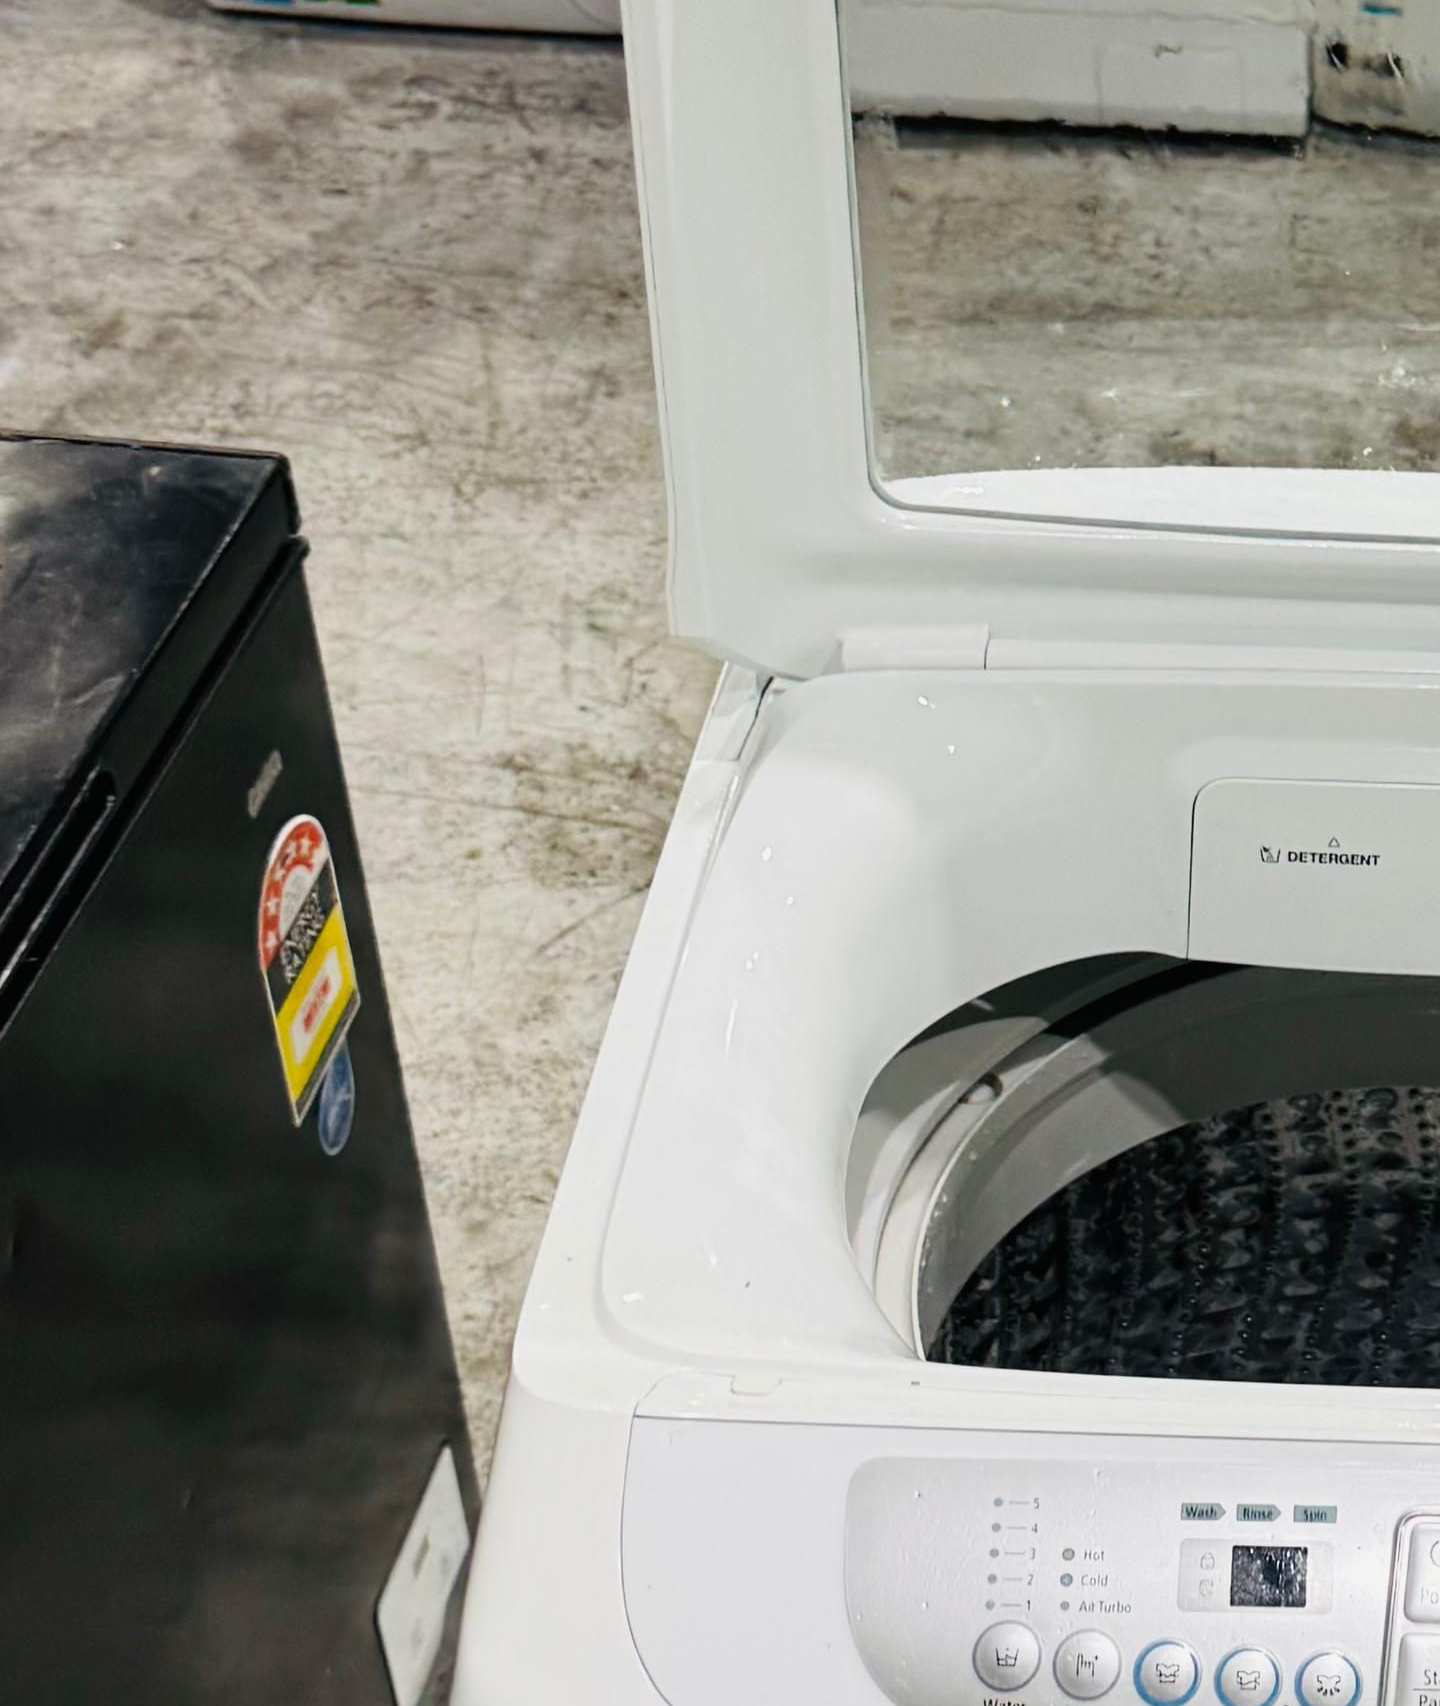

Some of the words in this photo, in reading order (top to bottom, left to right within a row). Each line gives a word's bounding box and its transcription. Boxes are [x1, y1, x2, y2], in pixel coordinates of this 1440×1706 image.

[1287, 850, 1381, 867] DETERGENT
[1033, 1497, 1040, 1509] 5
[1031, 1523, 1038, 1534] 4
[1083, 1549, 1105, 1561] Hot
[1027, 1574, 1034, 1586] 2
[1080, 1574, 1108, 1587] Cold
[1078, 1600, 1095, 1613] Air
[1099, 1600, 1132, 1614] Turbo
